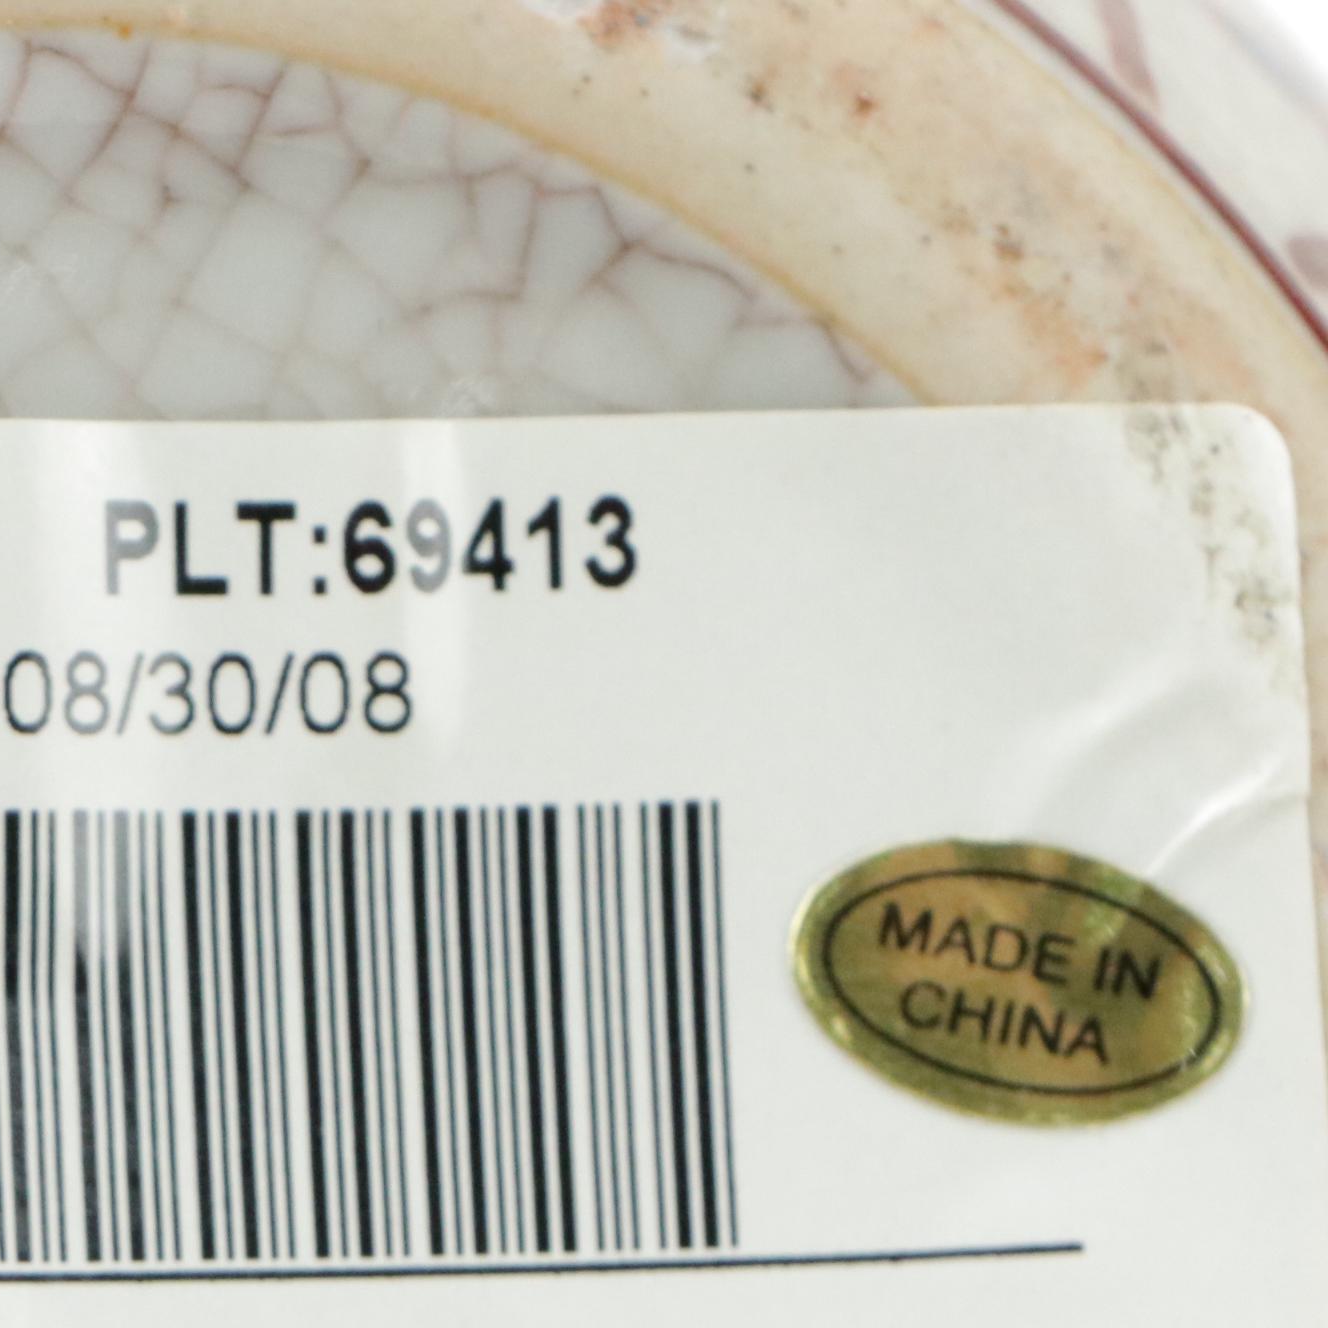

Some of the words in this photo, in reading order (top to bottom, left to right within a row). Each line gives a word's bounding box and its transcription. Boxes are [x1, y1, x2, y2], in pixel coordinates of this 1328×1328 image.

[104, 495, 637, 596] PLT:69413
[3, 650, 412, 735] 08/30/08
[878, 901, 1076, 986] MADE
[1093, 948, 1164, 1001] IN
[899, 979, 1109, 1065] CHINA
